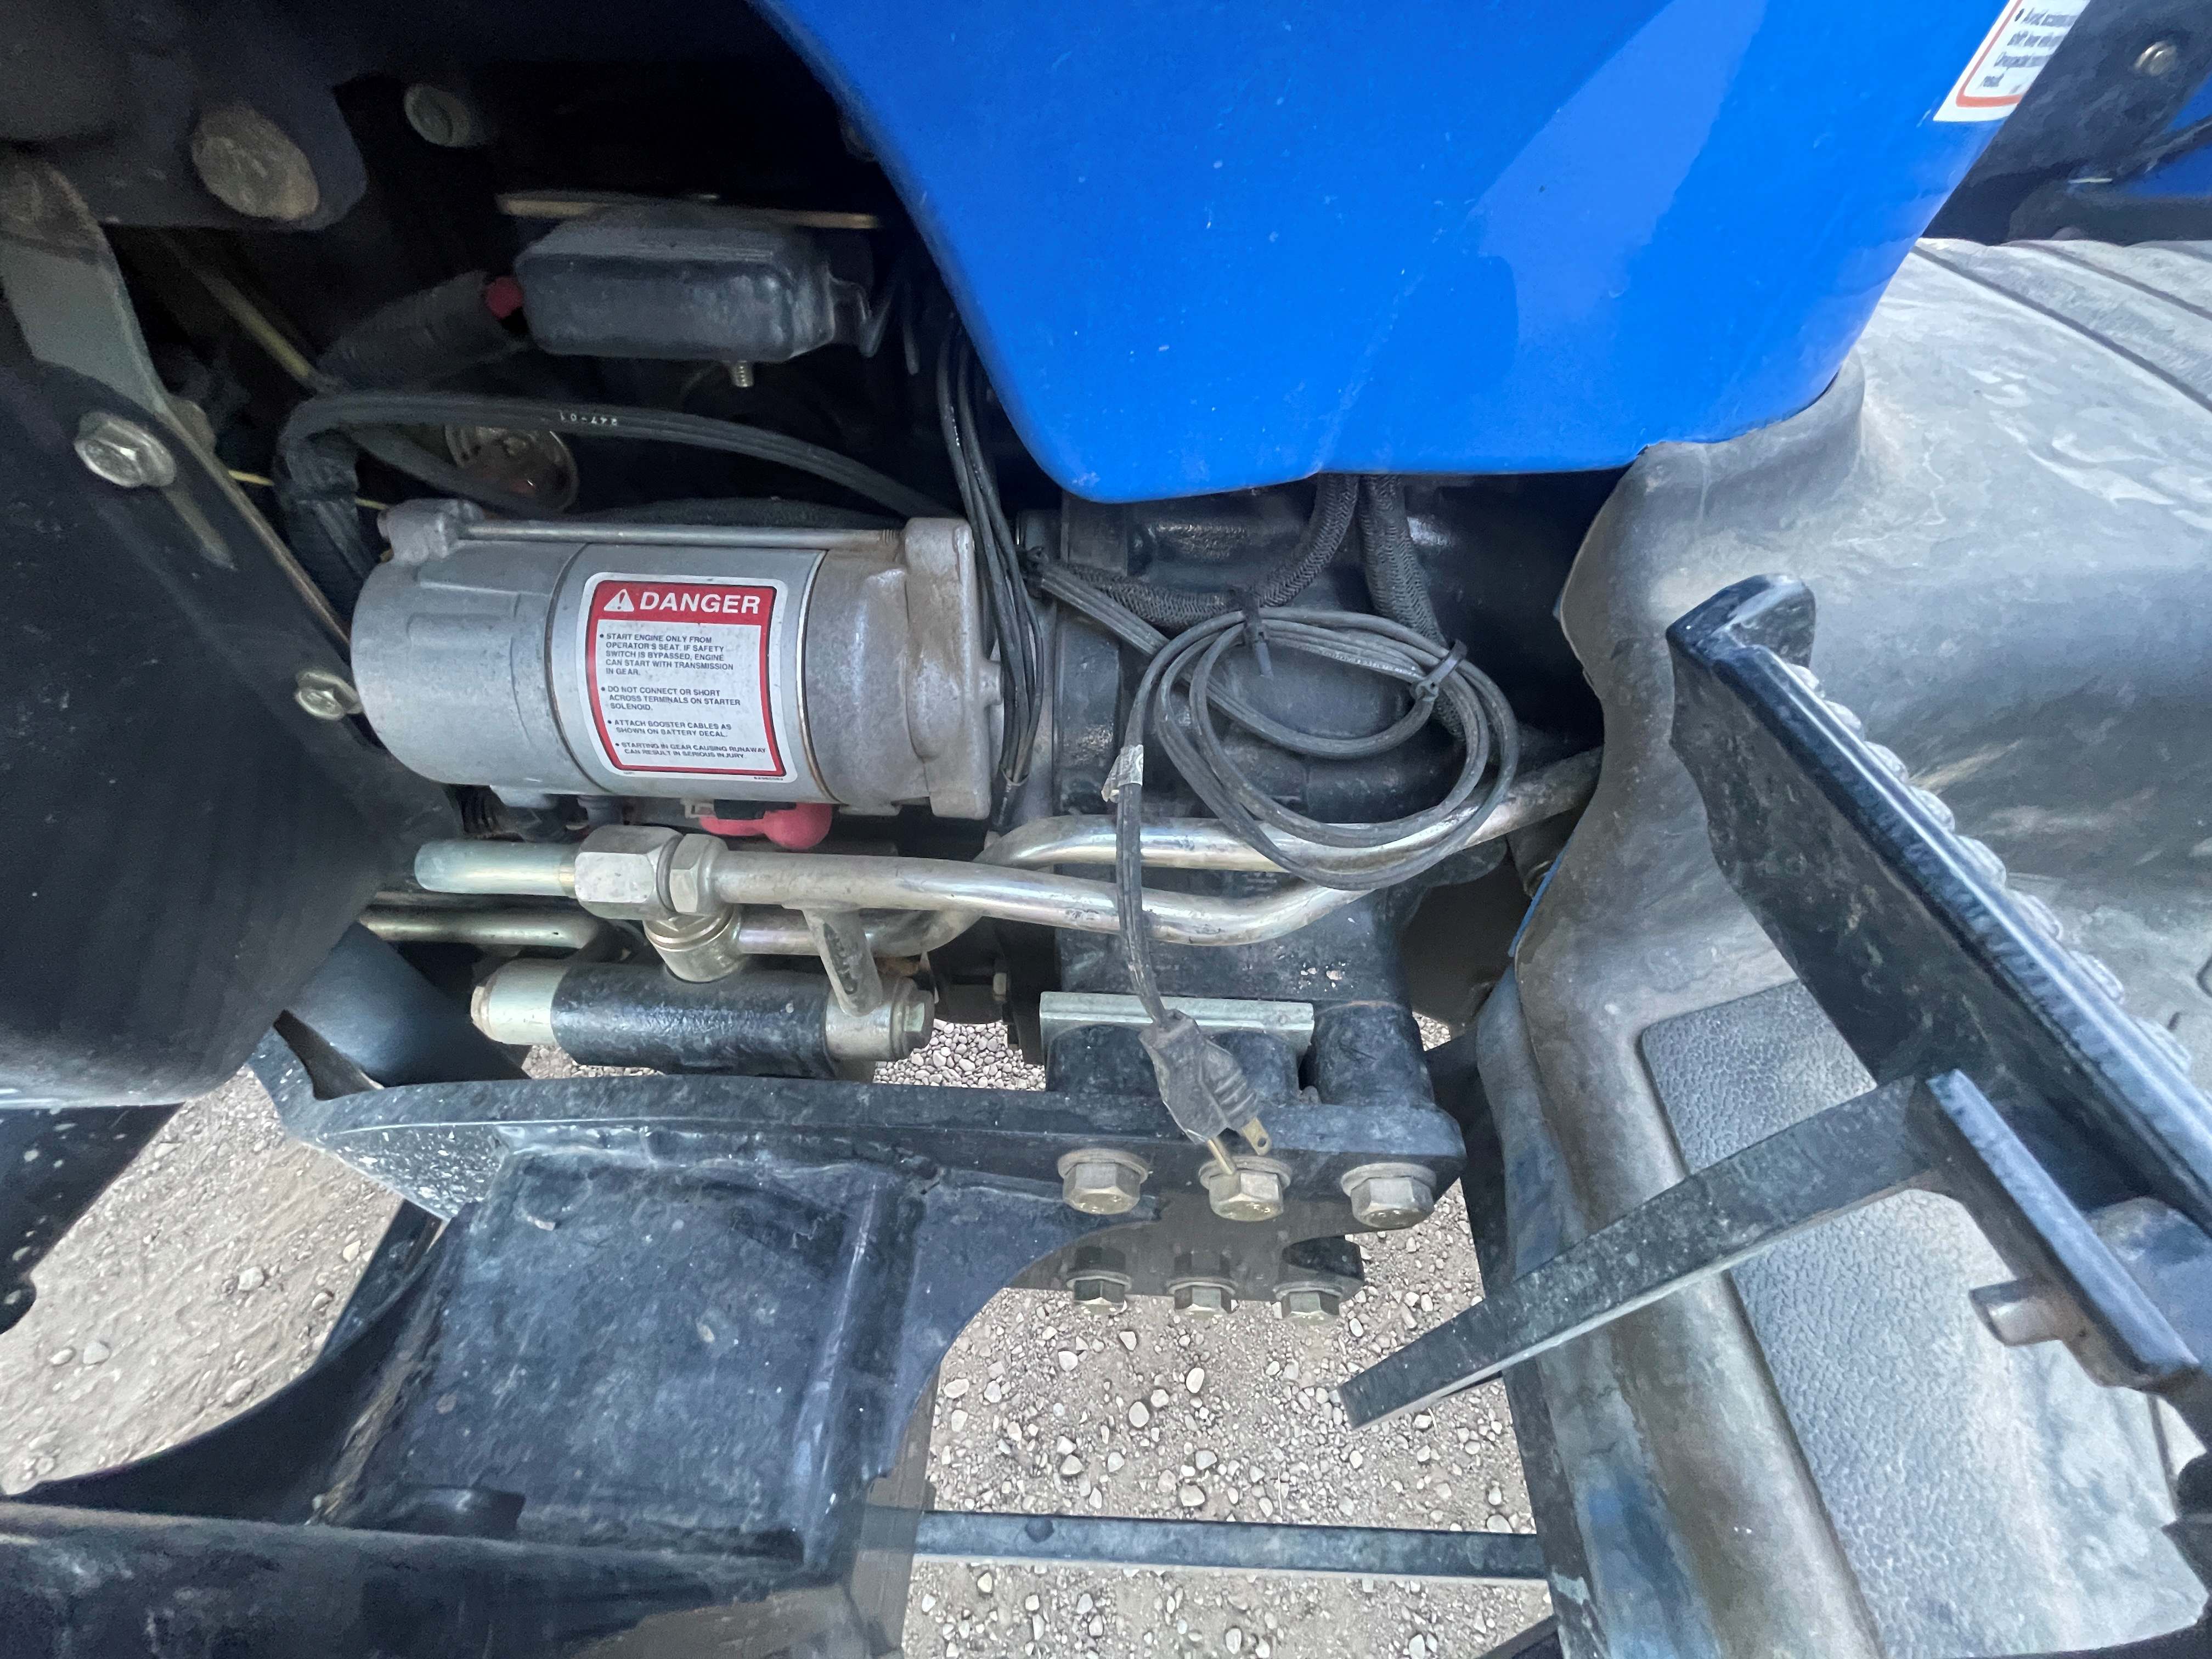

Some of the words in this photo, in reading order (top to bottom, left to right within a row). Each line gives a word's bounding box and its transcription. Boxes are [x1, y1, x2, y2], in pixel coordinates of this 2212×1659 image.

[640, 591, 761, 614] DANGER
[647, 652, 692, 661] BYPASSED,
[674, 661, 733, 670] TRANSMISSION
[644, 696, 689, 704] TERMINALS
[610, 702, 653, 711] SOLENOID.
